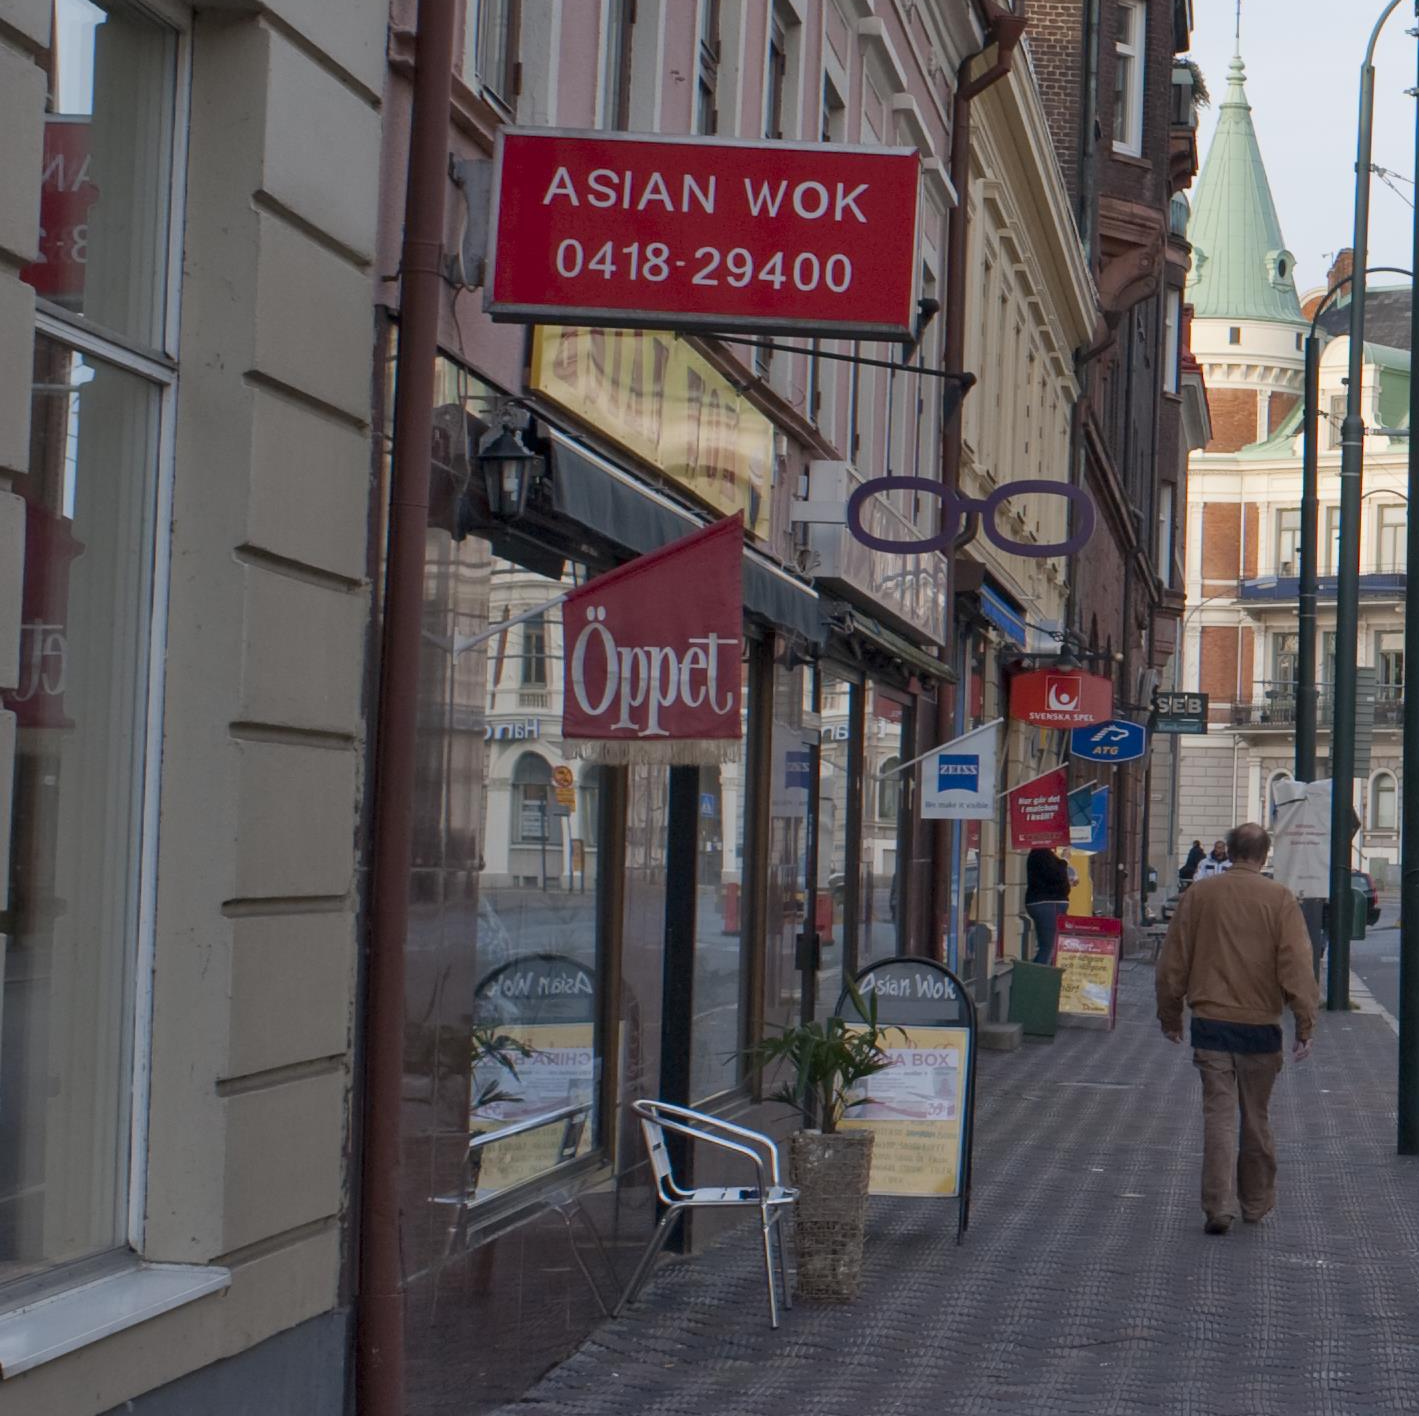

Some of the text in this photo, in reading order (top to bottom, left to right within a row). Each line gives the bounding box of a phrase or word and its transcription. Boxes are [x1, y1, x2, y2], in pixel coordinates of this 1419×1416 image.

[543, 166, 870, 224] ASIAN WOK
[556, 238, 852, 293] 0418-29400
[571, 605, 739, 737] Öppet
[1156, 696, 1203, 714] SEB
[1028, 711, 1095, 722] SVENSKA SPEL
[1092, 745, 1119, 755] ATG
[939, 764, 978, 775] ZEISS
[859, 972, 957, 1000] Asian Wok
[912, 1052, 950, 1067] BOX
